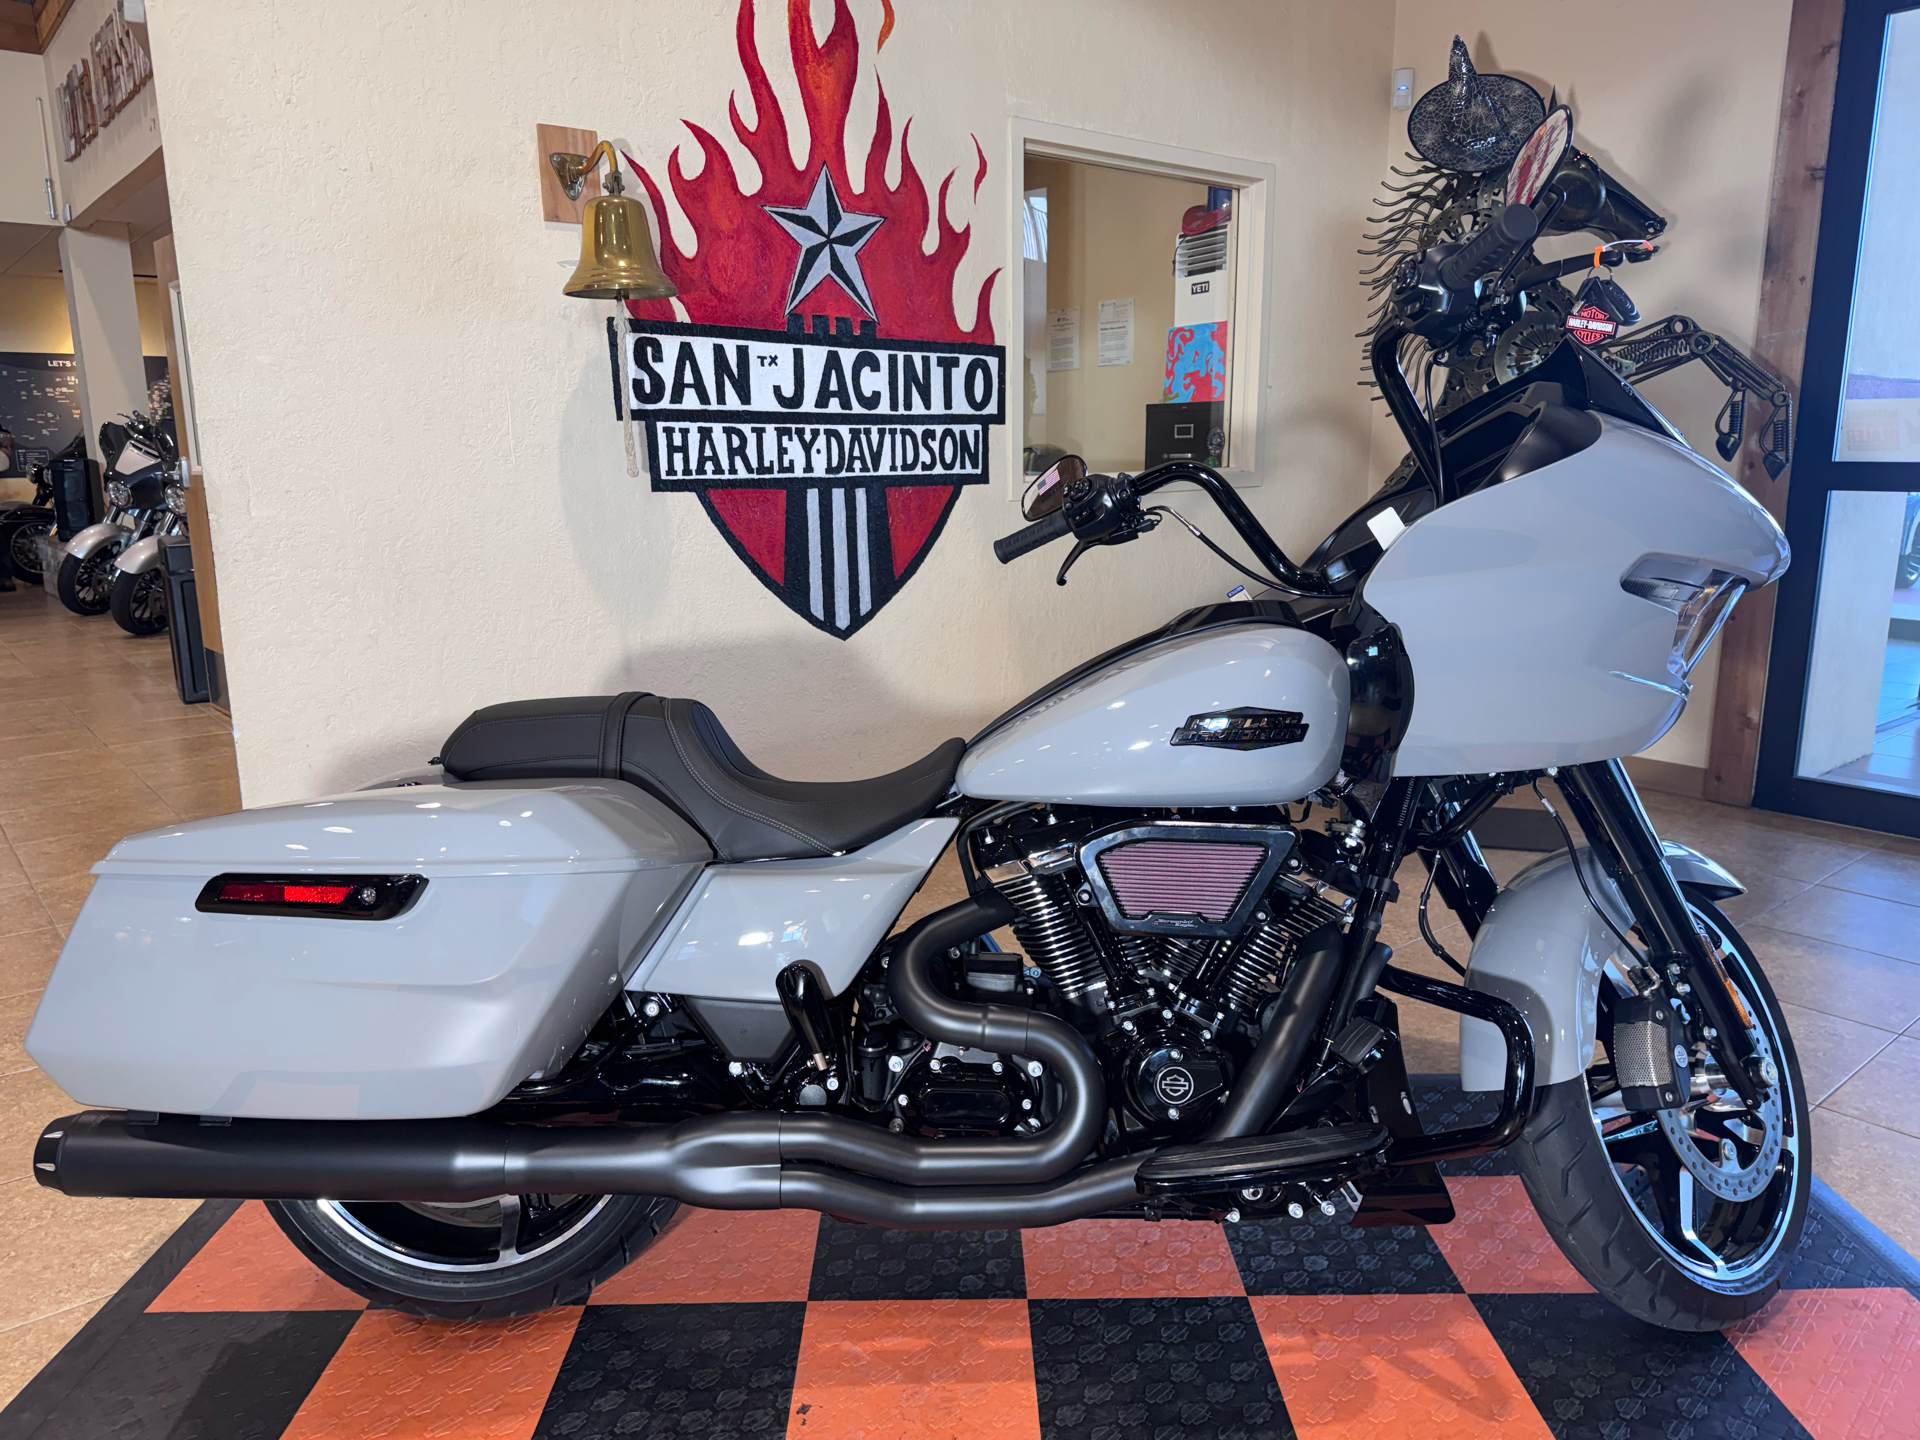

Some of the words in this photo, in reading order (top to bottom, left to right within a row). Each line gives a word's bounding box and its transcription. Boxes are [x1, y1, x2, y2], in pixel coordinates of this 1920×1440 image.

[1191, 282, 1209, 294] YETI
[1580, 309, 1605, 320] MOTOR
[1568, 317, 1613, 332] HARLEY-DAVIDSON
[632, 336, 751, 405] SAN
[757, 354, 778, 367] TX
[773, 348, 993, 411] JACINTO
